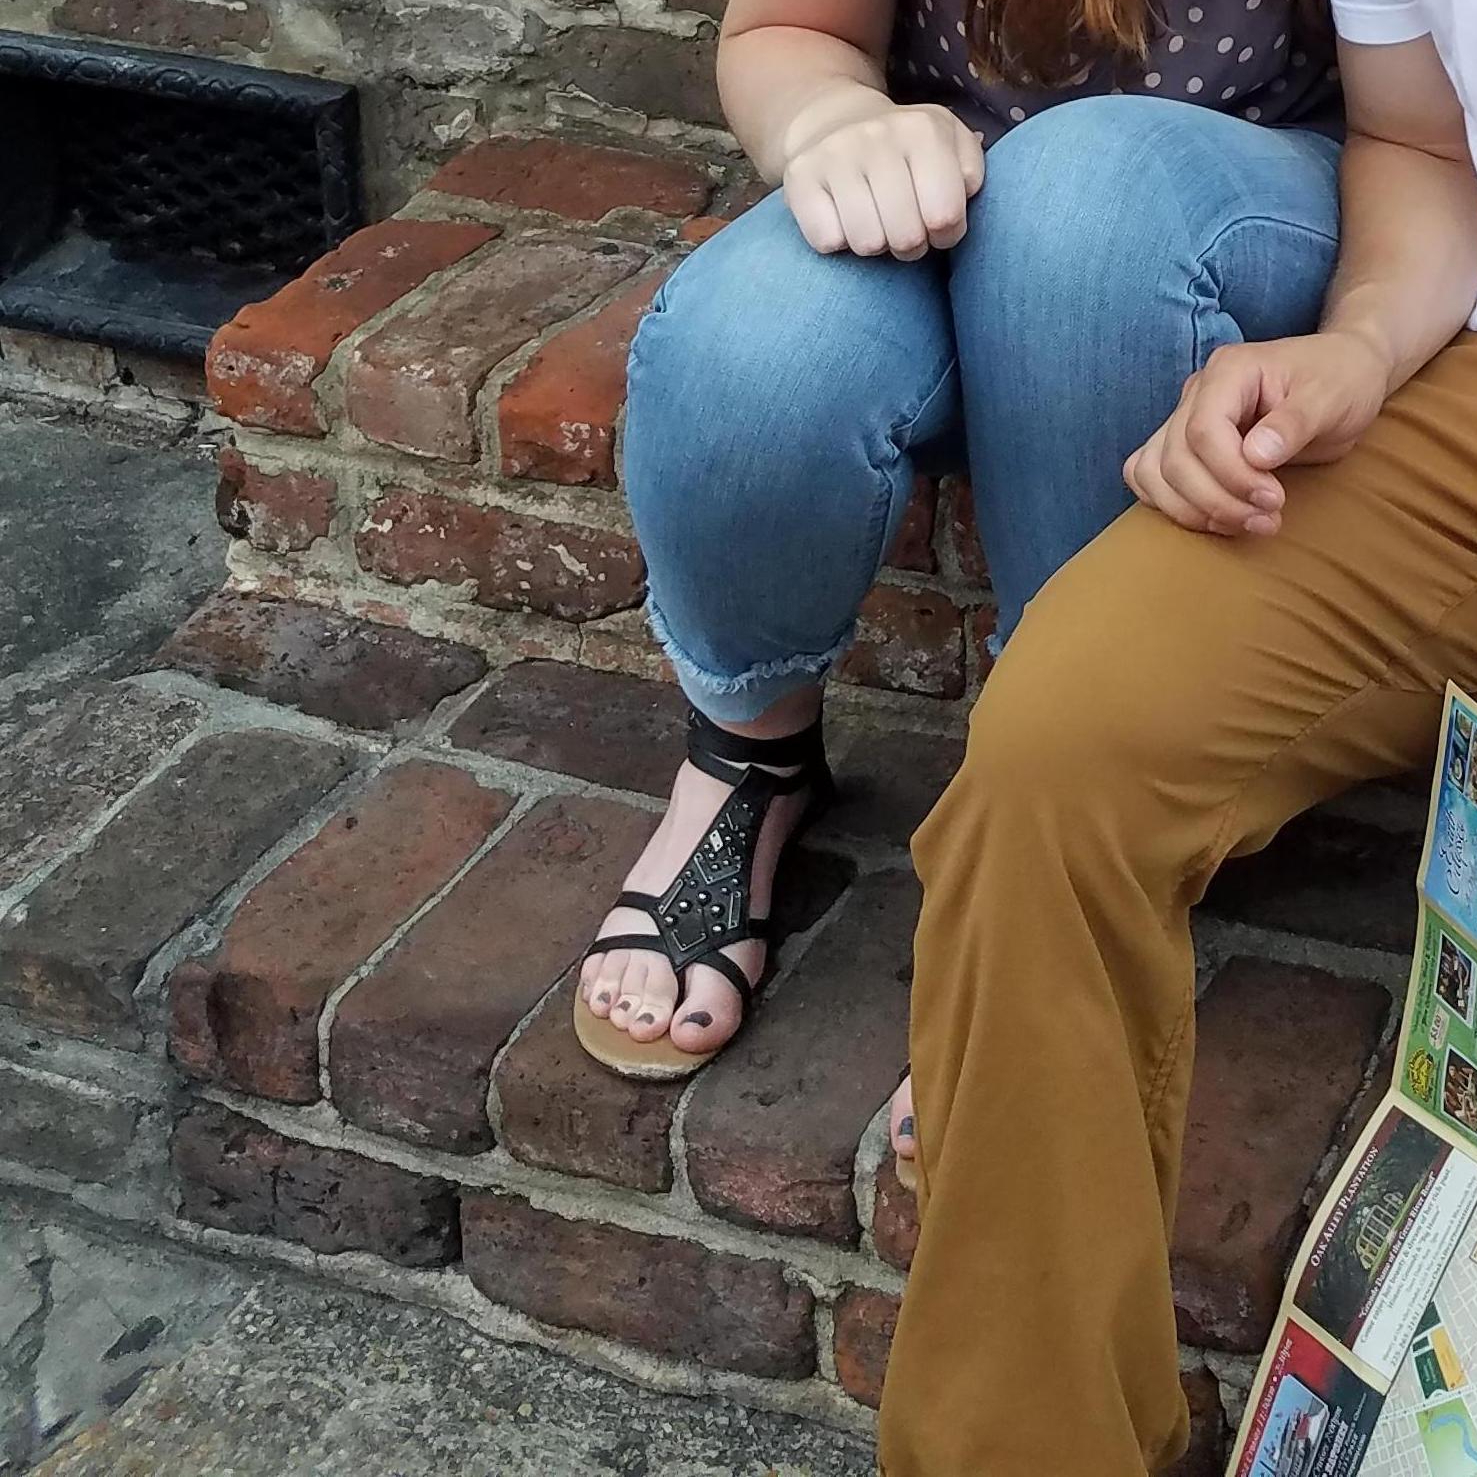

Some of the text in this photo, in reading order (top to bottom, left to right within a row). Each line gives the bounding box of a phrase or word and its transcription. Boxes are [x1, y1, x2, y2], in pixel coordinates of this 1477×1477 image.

[1310, 1146, 1379, 1267] OAK ALLEY PLANTATION
